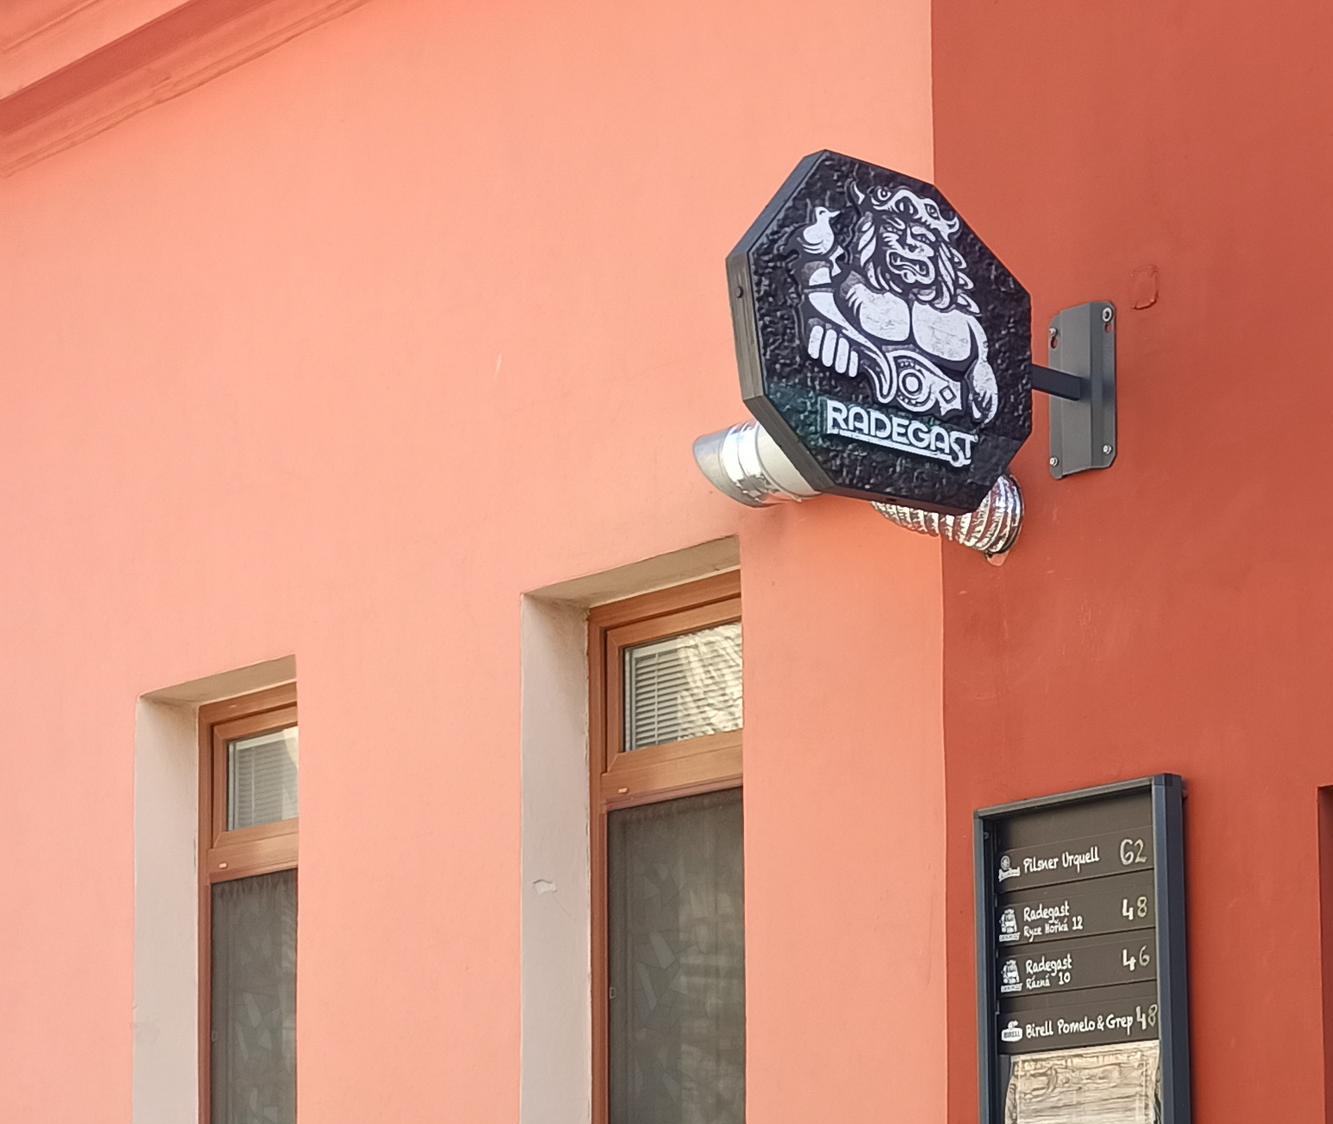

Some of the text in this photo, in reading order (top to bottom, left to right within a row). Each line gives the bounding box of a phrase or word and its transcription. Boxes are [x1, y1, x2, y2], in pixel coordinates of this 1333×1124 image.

[827, 399, 976, 467] RADEGAST
[1023, 856, 1059, 873] Pilsner
[1061, 846, 1100, 873] Urquell
[1023, 897, 1148, 924] Radegast 48
[1072, 915, 1084, 931] 12
[1025, 945, 1151, 976] Radegast 46
[1058, 972, 1071, 986] 10
[1025, 1020, 1053, 1039] Birell
[1057, 1016, 1096, 1035] Pomelo
[1106, 1013, 1134, 1036] Grep
[1136, 1003, 1158, 1030] 48
